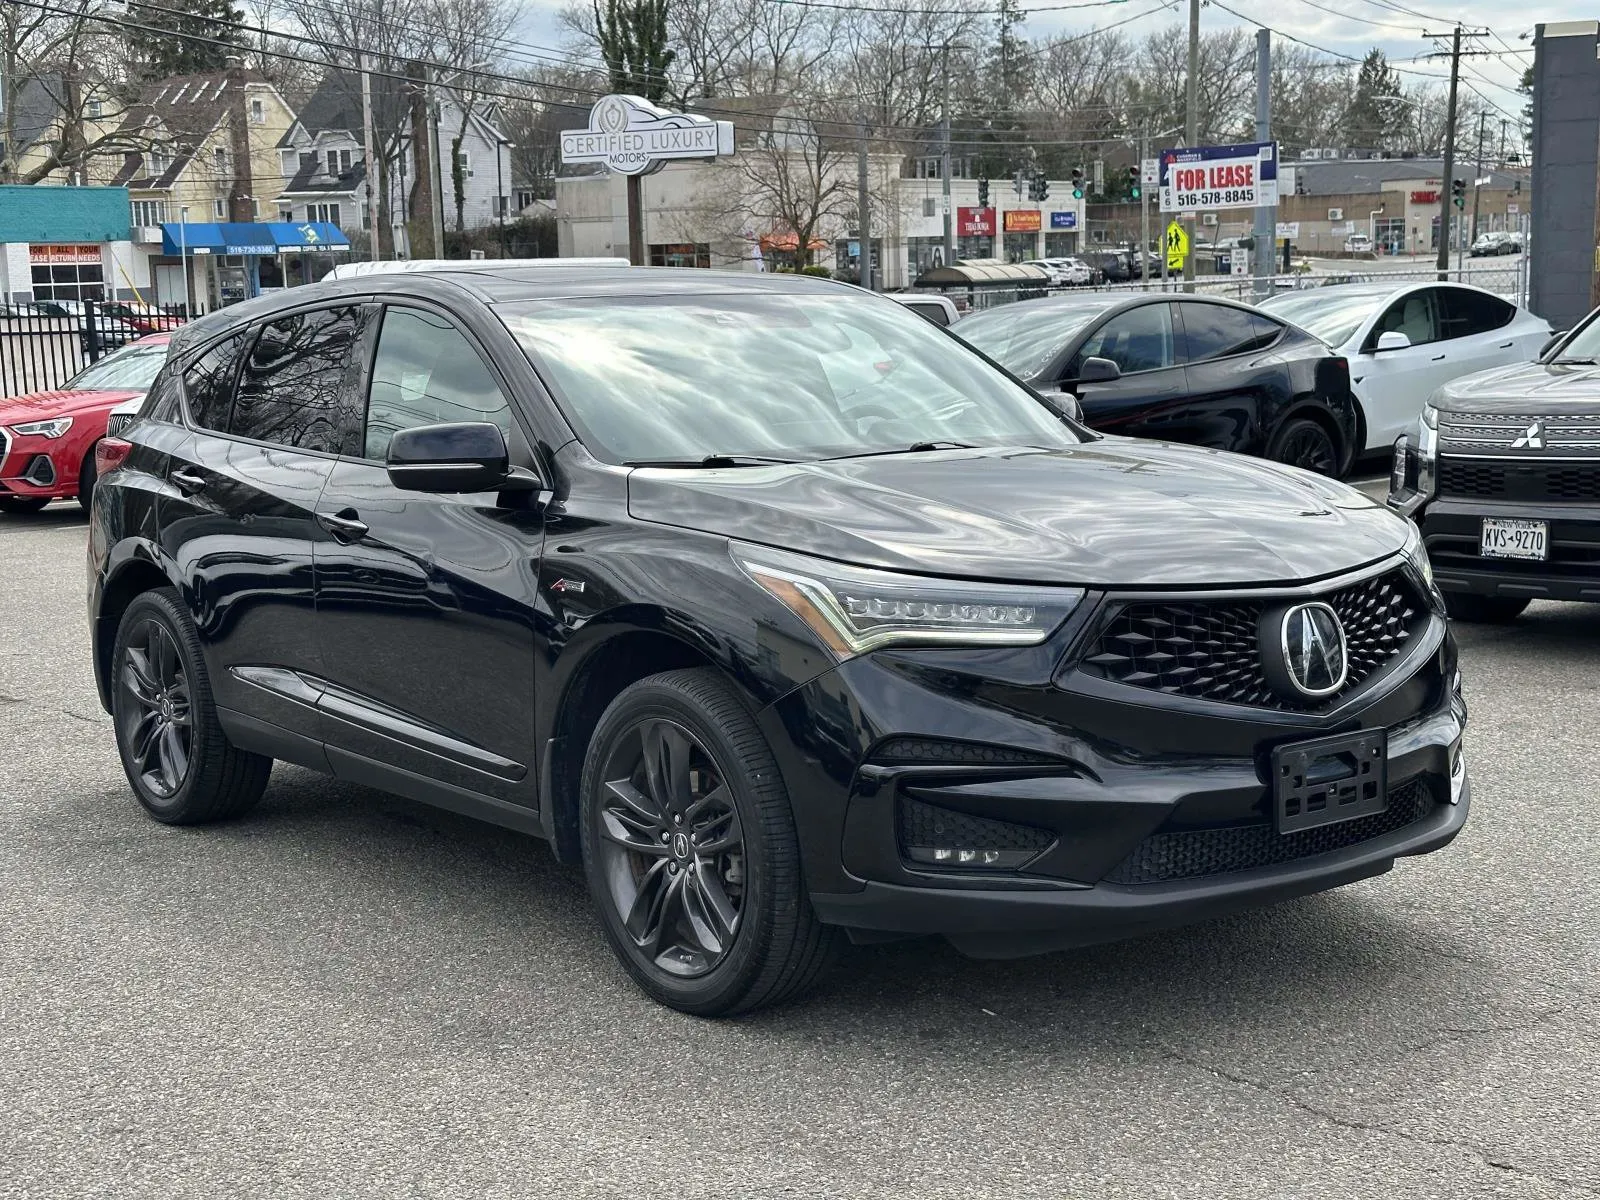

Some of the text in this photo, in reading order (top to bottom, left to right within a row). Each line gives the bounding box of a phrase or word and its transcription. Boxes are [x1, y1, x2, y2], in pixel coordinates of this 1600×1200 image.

[563, 130, 716, 154] CERTIFIED LUXURY
[609, 152, 646, 164] MOTORS
[1175, 164, 1254, 192] FOR LEASE
[1177, 189, 1254, 207] 516-578-8845
[57, 246, 69, 254] ALL
[80, 245, 98, 254] YOUR
[29, 253, 101, 262] EASE RETURN NEEDS
[1497, 520, 1533, 531] NEW YORK
